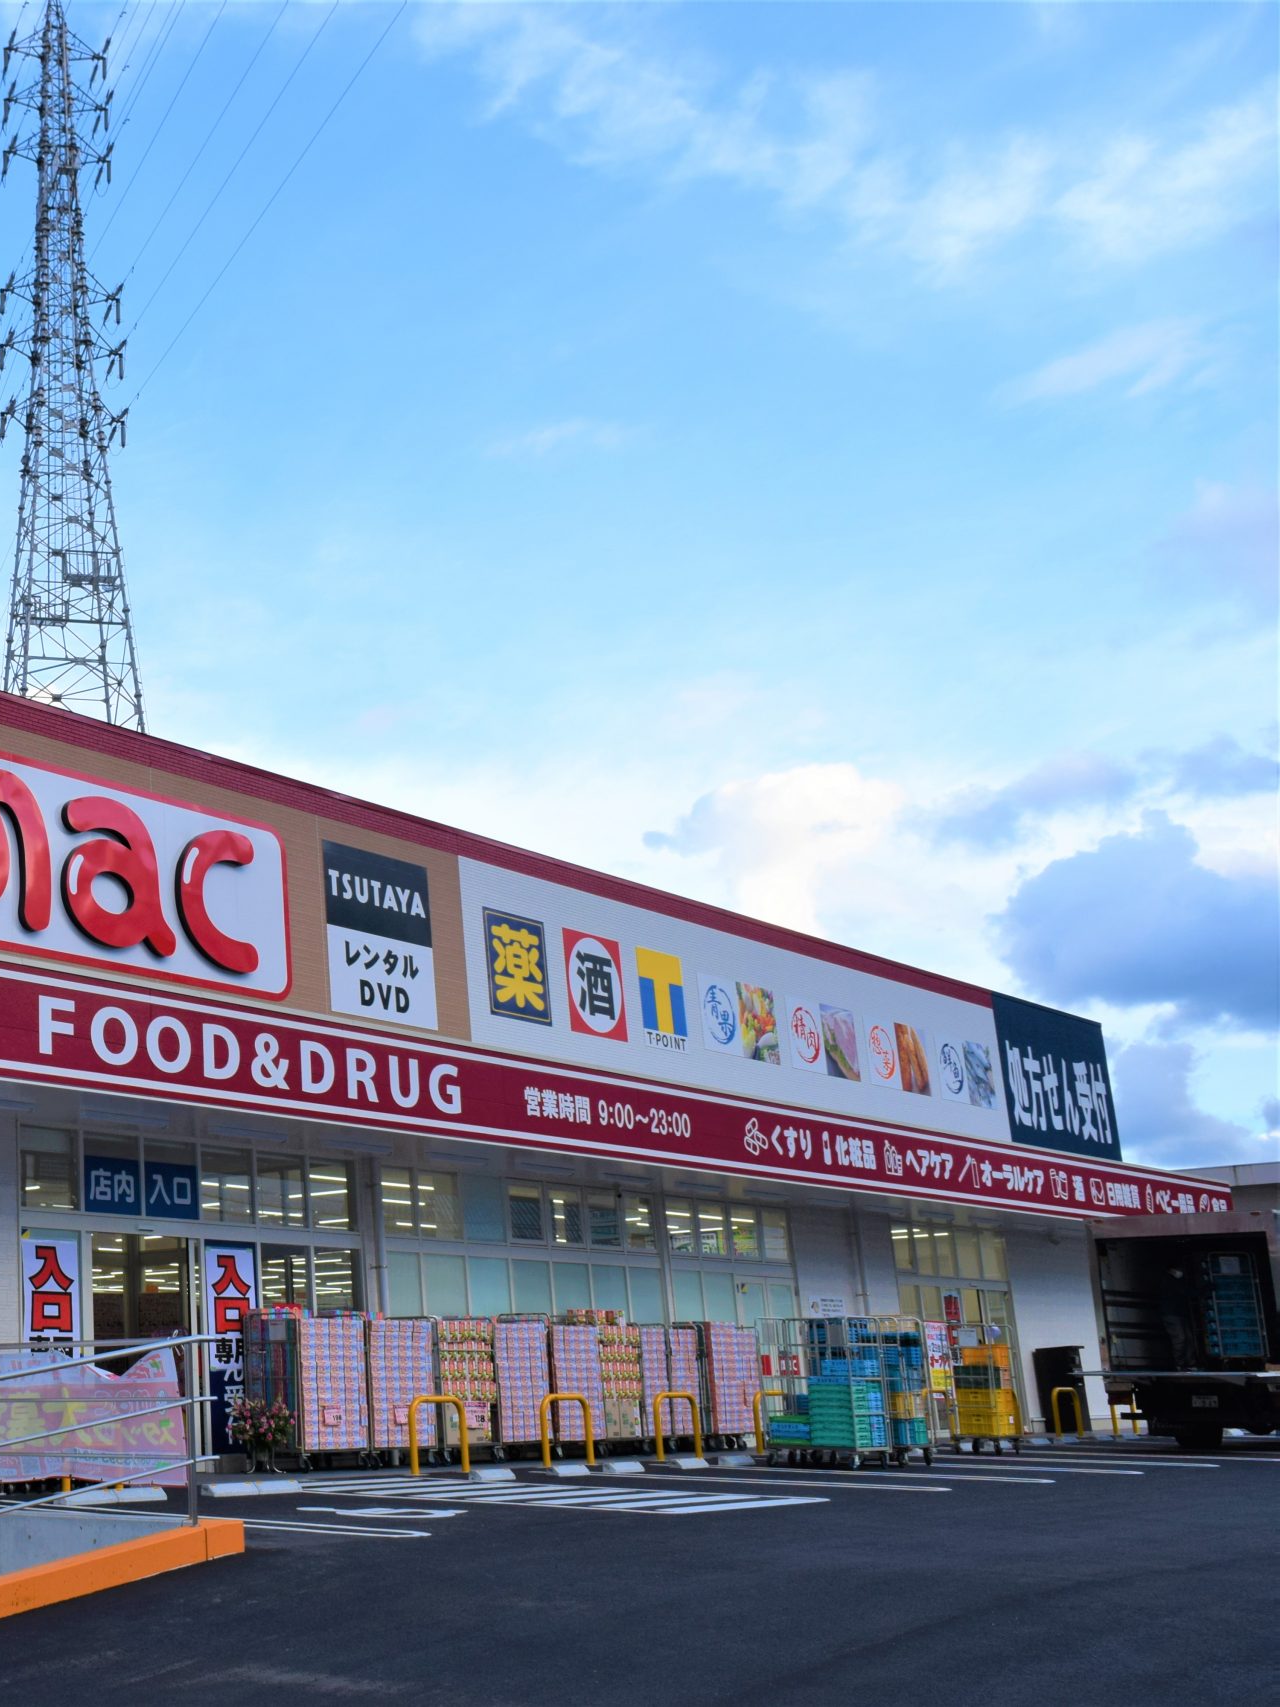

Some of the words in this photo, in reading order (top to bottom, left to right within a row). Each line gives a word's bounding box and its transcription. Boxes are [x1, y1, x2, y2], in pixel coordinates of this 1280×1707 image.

[327, 868, 426, 919] TSUTAYA
[344, 940, 419, 979] レンタル
[490, 923, 545, 1011] 薬
[576, 950, 616, 1021] 酒
[359, 980, 410, 1014] DVD
[38, 995, 463, 1115] FOOD&DRUG
[523, 1086, 591, 1125] 営業時間
[1005, 1040, 1112, 1144] 処方せん受付
[89, 1168, 135, 1203] 店内
[150, 1174, 192, 1206] 入口
[771, 1125, 812, 1159] くすり
[835, 1135, 877, 1170] 化粧品
[906, 1149, 953, 1180] ヘアケア
[980, 1160, 1044, 1194] オーラルケア
[1072, 1175, 1085, 1202] 酒
